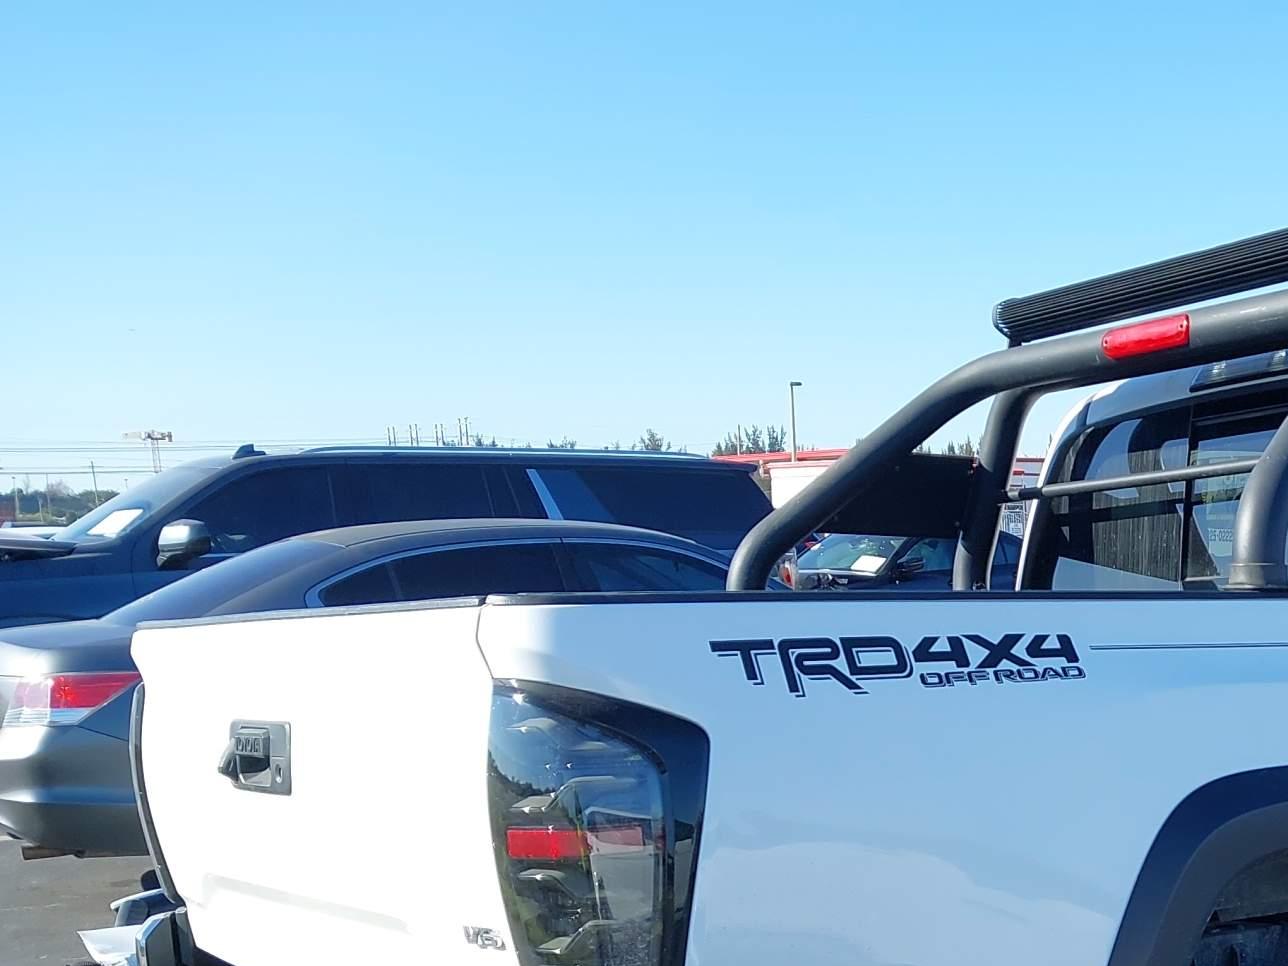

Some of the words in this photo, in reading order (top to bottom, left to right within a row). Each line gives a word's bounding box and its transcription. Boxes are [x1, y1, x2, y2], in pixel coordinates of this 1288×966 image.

[708, 636, 914, 698] TRD
[920, 668, 995, 688] OFF
[994, 665, 1086, 685] ROAD
[463, 926, 506, 951] V6
